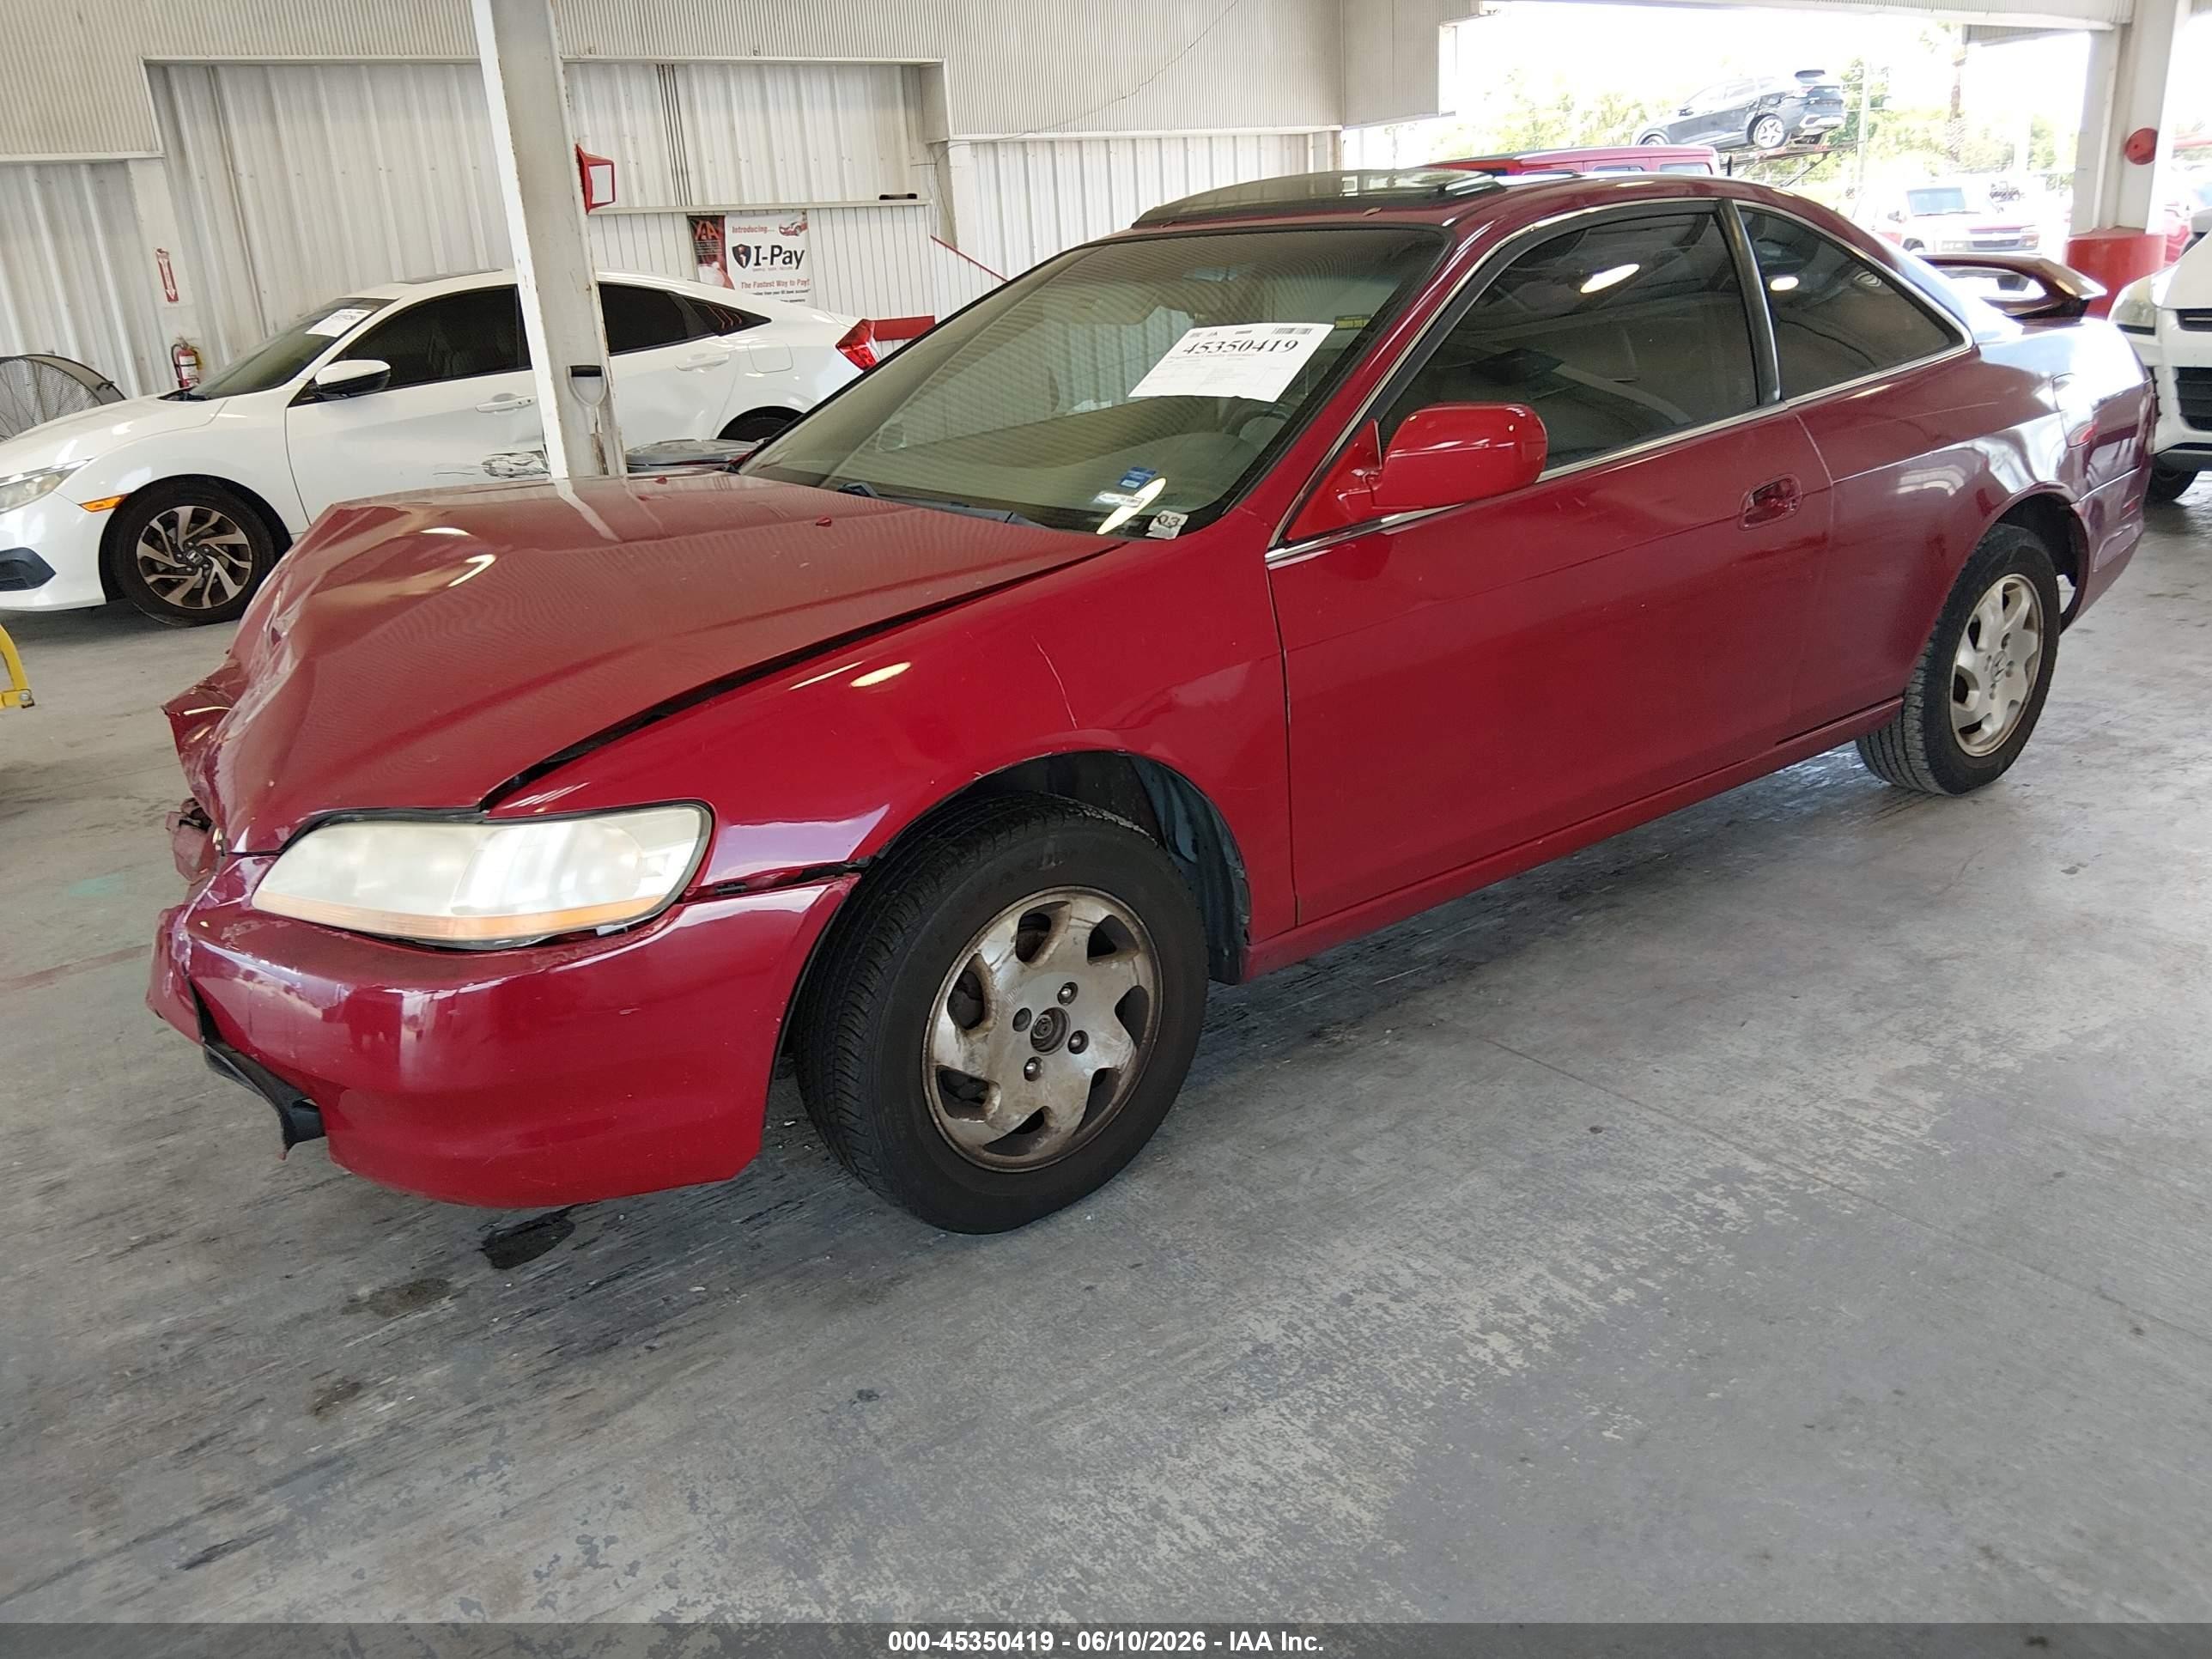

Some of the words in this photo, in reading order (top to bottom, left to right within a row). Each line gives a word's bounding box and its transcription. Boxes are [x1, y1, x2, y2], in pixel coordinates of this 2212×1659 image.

[754, 245, 805, 270] I-Pay
[753, 280, 775, 289] Fastest
[1183, 338, 1298, 355] 45350419
